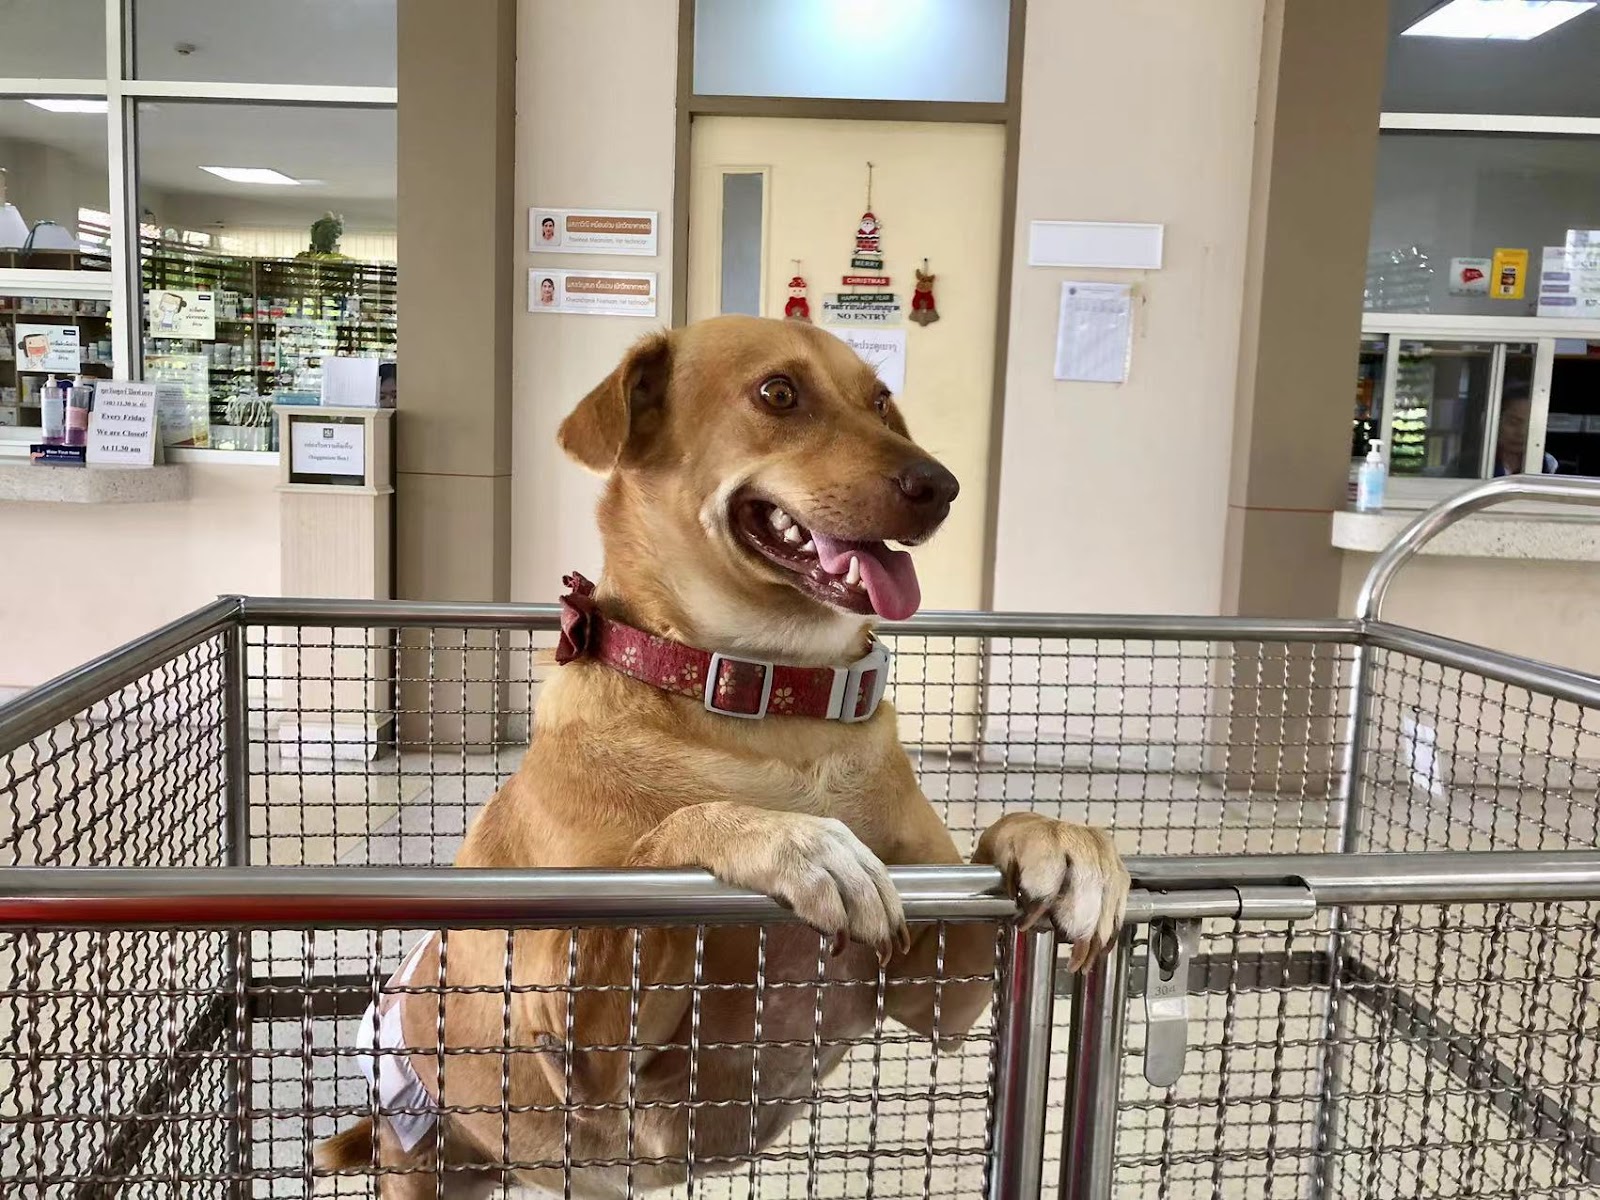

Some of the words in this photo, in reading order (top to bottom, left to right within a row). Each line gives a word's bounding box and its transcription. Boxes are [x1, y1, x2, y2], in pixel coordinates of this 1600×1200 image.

[854, 313, 888, 321] ENTRY
[101, 413, 122, 422] Every
[122, 413, 146, 422] Friday
[96, 428, 108, 437] We
[122, 429, 148, 438] Closed!
[111, 445, 129, 453] 11.30
[1155, 985, 1176, 997] 304
